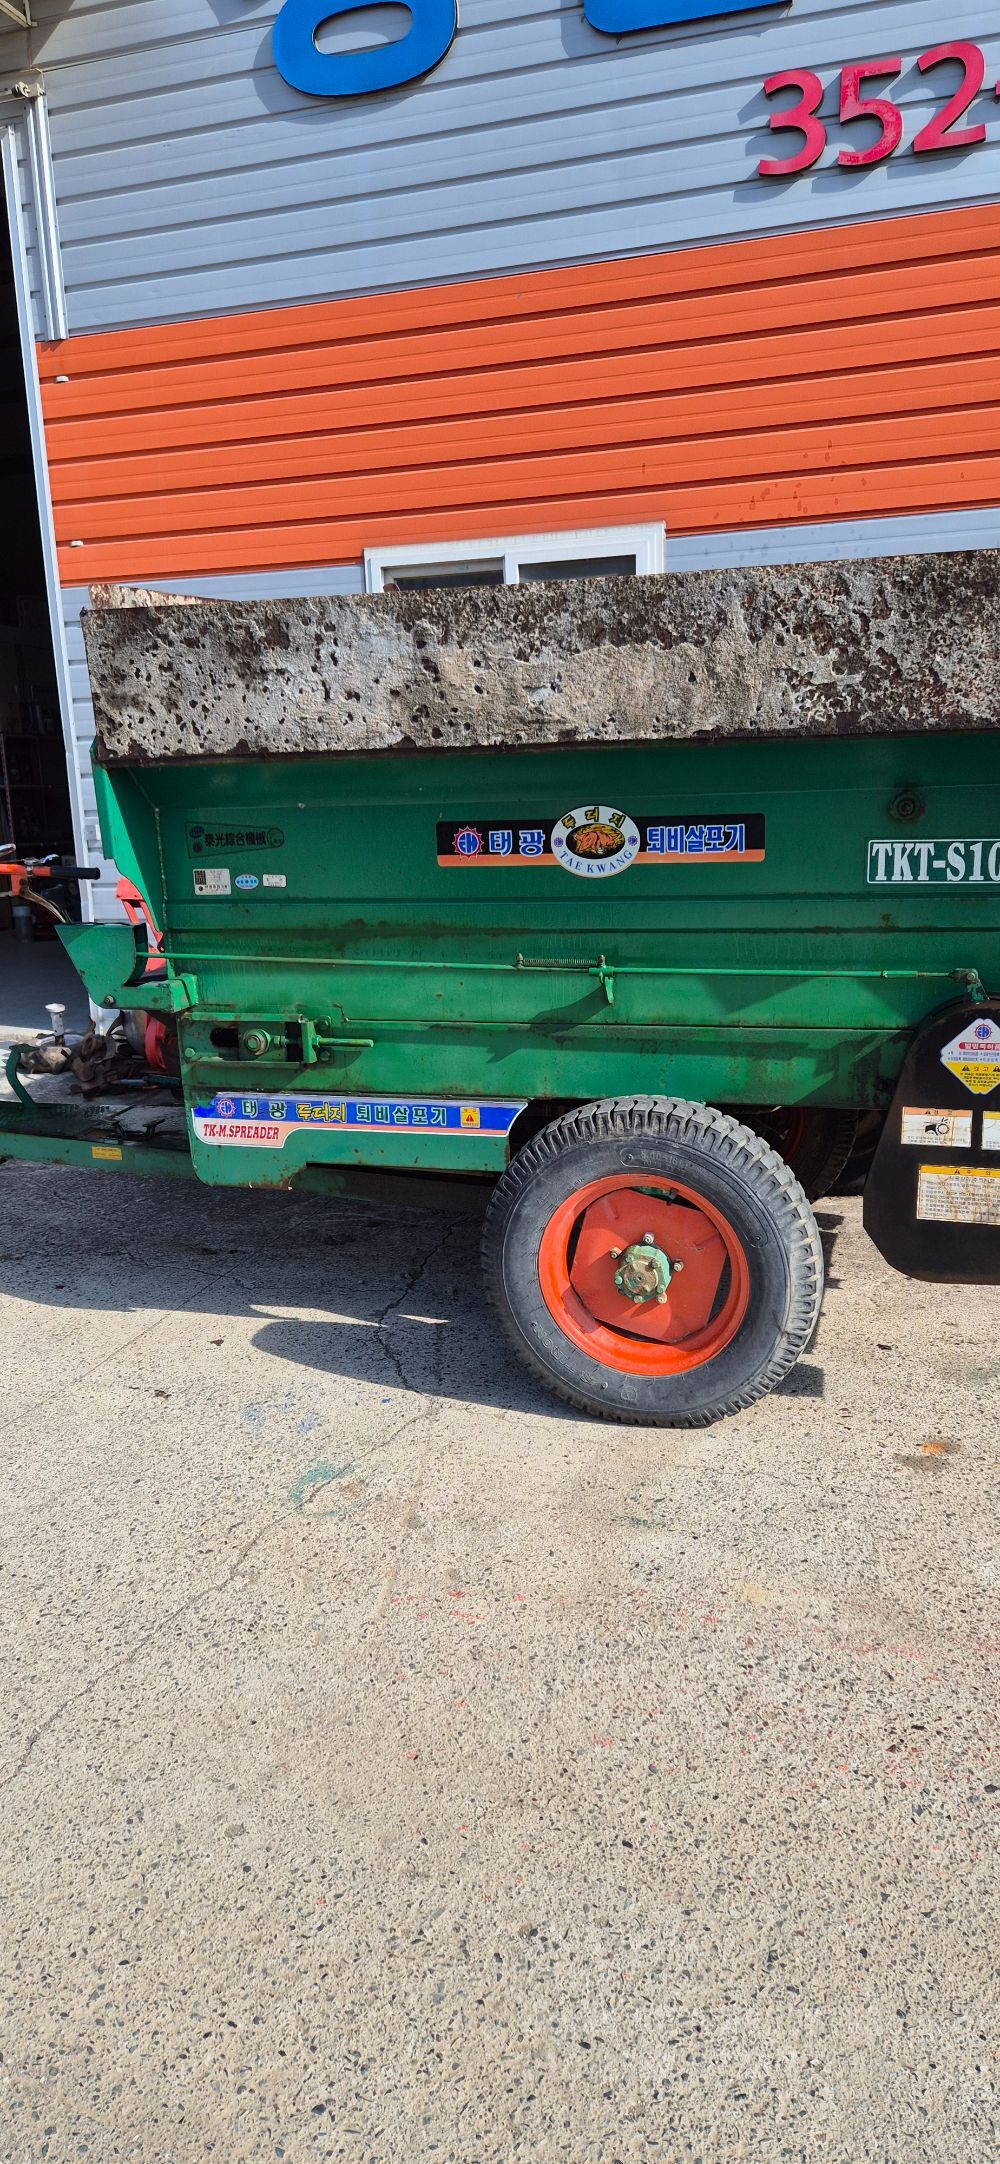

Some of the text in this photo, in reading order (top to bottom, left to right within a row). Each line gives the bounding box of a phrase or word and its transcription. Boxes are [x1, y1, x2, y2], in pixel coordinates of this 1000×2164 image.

[757, 41, 1000, 175] 352
[646, 823, 746, 856] 퇴비살포기
[586, 849, 634, 874] KWANG
[296, 1101, 347, 1124] 두더지
[356, 1104, 447, 1126] 퇴비살포기
